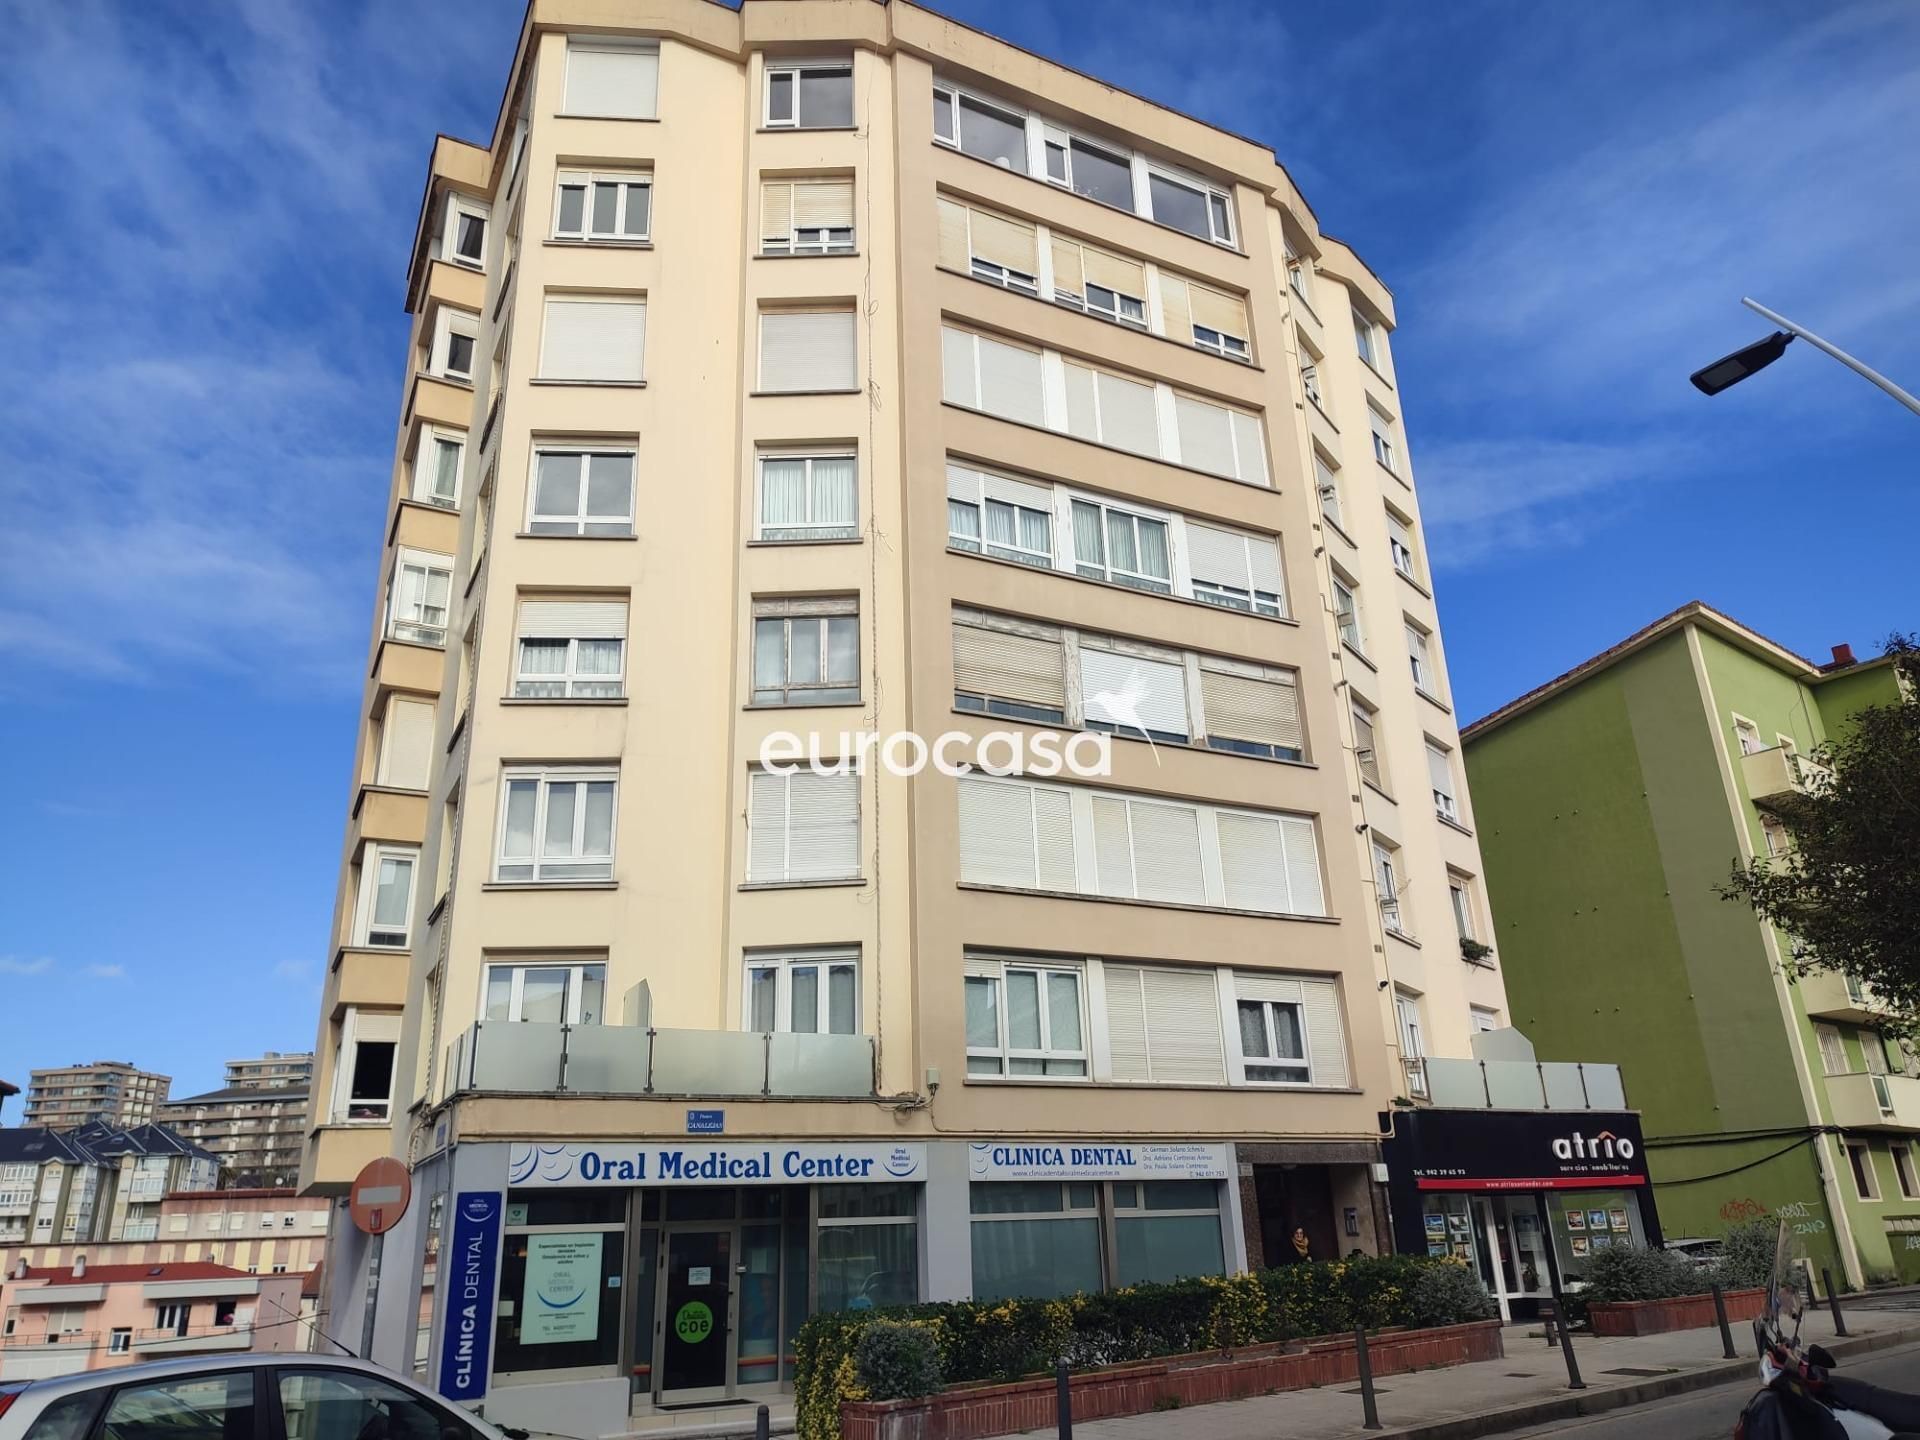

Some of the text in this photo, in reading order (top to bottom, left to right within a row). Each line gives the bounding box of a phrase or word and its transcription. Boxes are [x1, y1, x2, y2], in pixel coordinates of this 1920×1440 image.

[580, 1150, 874, 1180] Oral Medical Center
[992, 1147, 1137, 1166] CLINICA DENTAL
[455, 1231, 484, 1389] CLÍNICA DENTAL
[679, 1320, 709, 1334] coe
